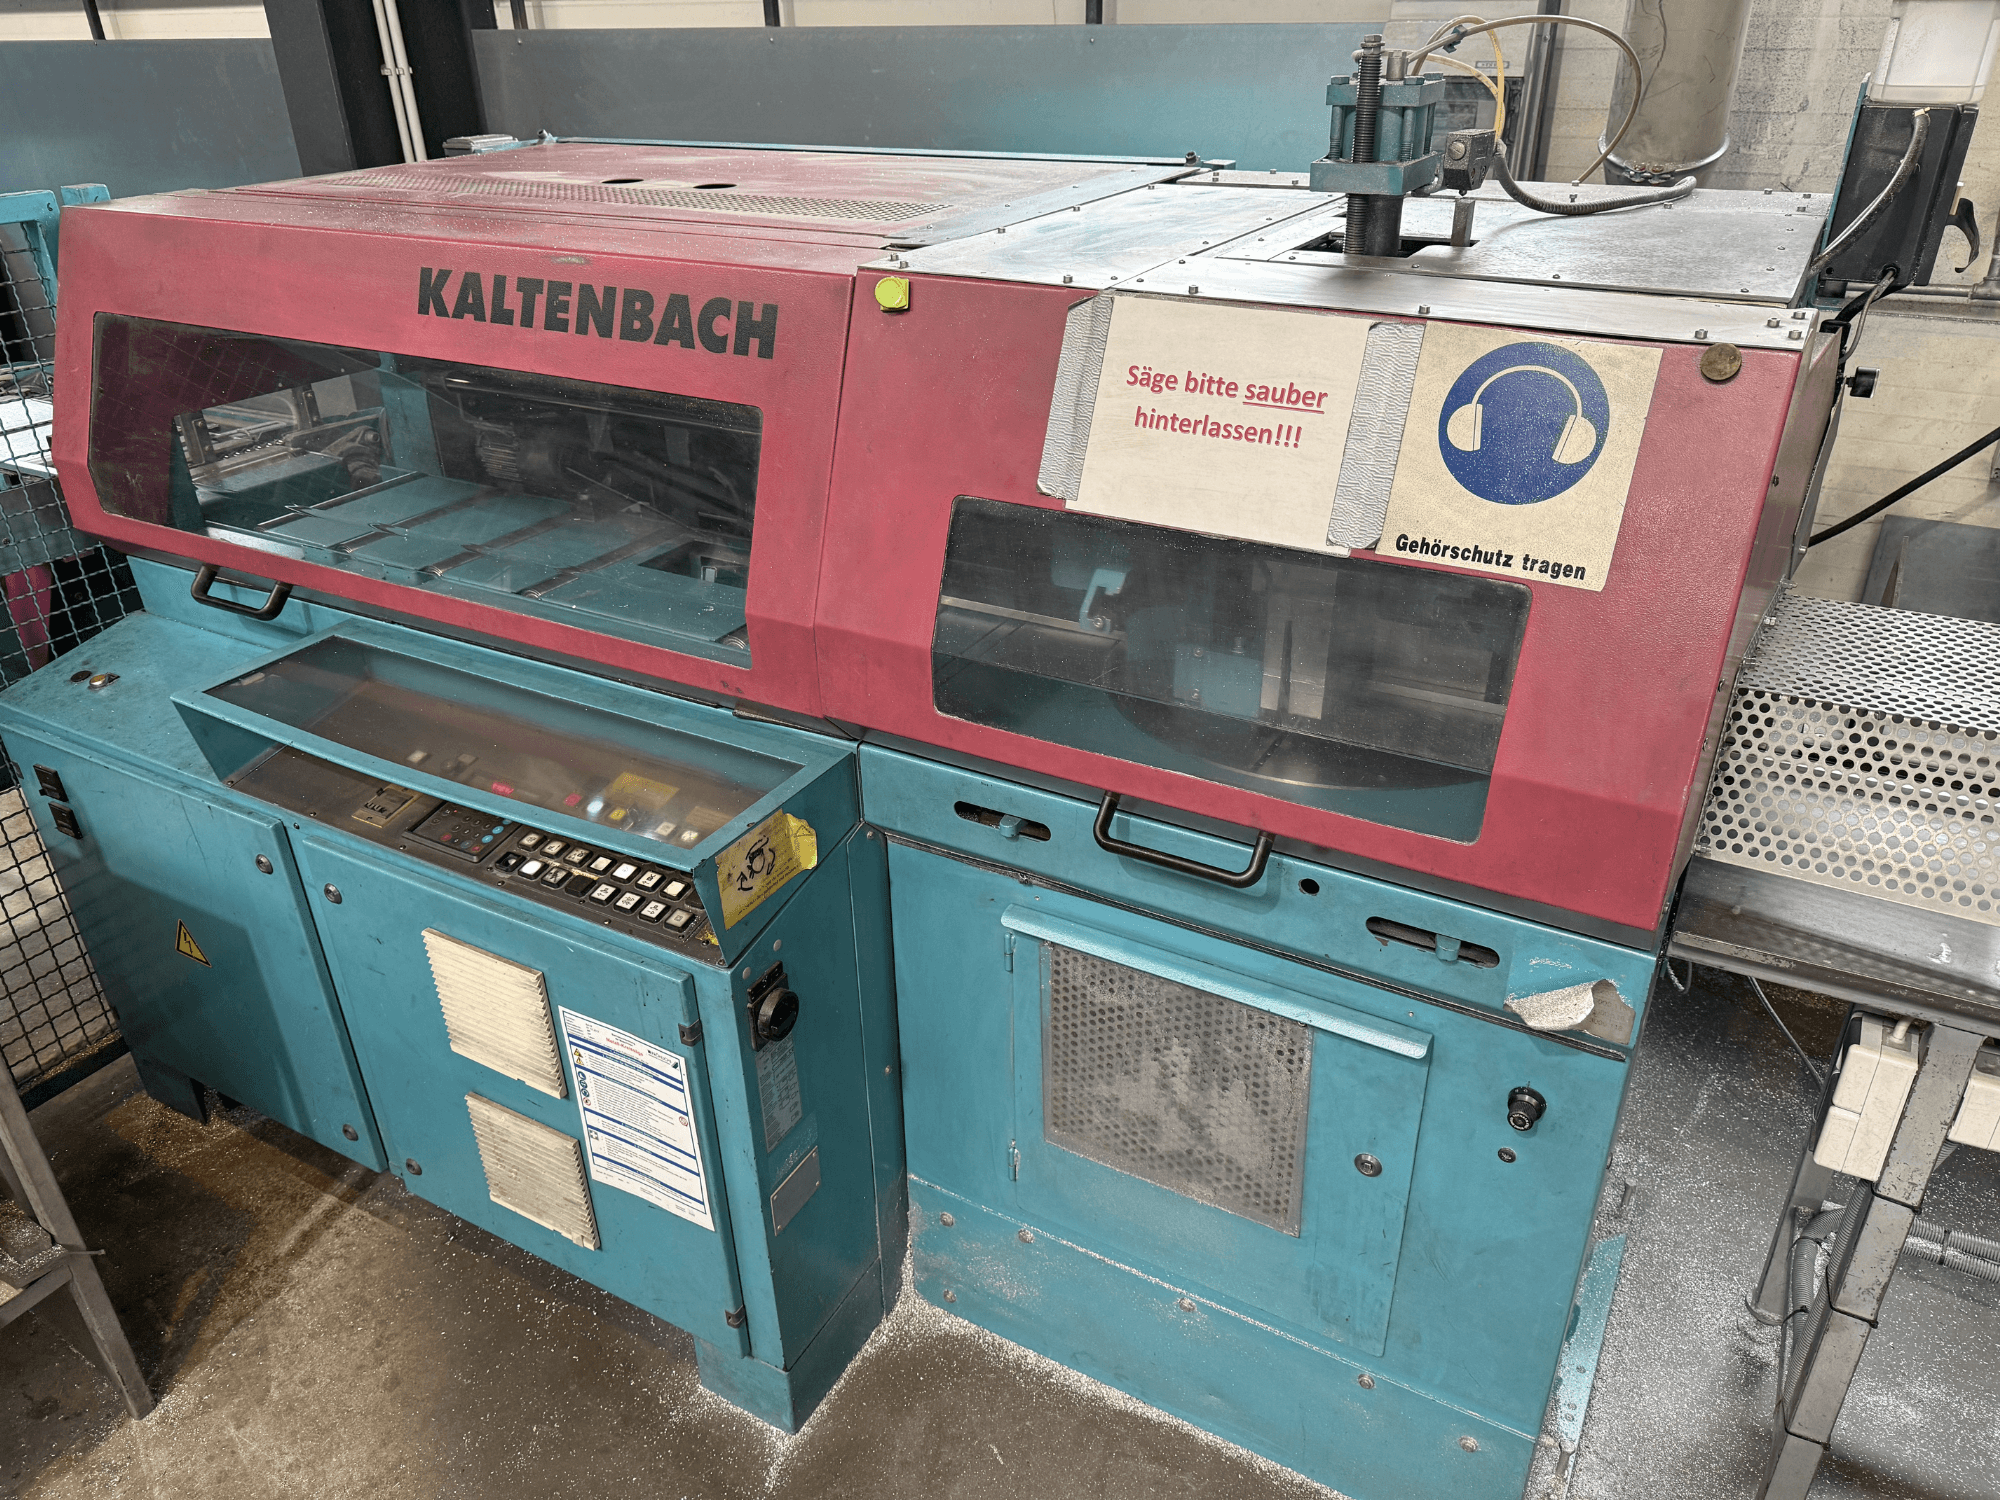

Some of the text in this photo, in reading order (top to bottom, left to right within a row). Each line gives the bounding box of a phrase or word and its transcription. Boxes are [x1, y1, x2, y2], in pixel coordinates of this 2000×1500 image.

[417, 267, 778, 359] KALTENBACH
[1126, 364, 1329, 410] Säge bitte sauber
[1134, 406, 1303, 449] hinterlassen!!!
[1395, 533, 1586, 581] Gehörschutz tragen
